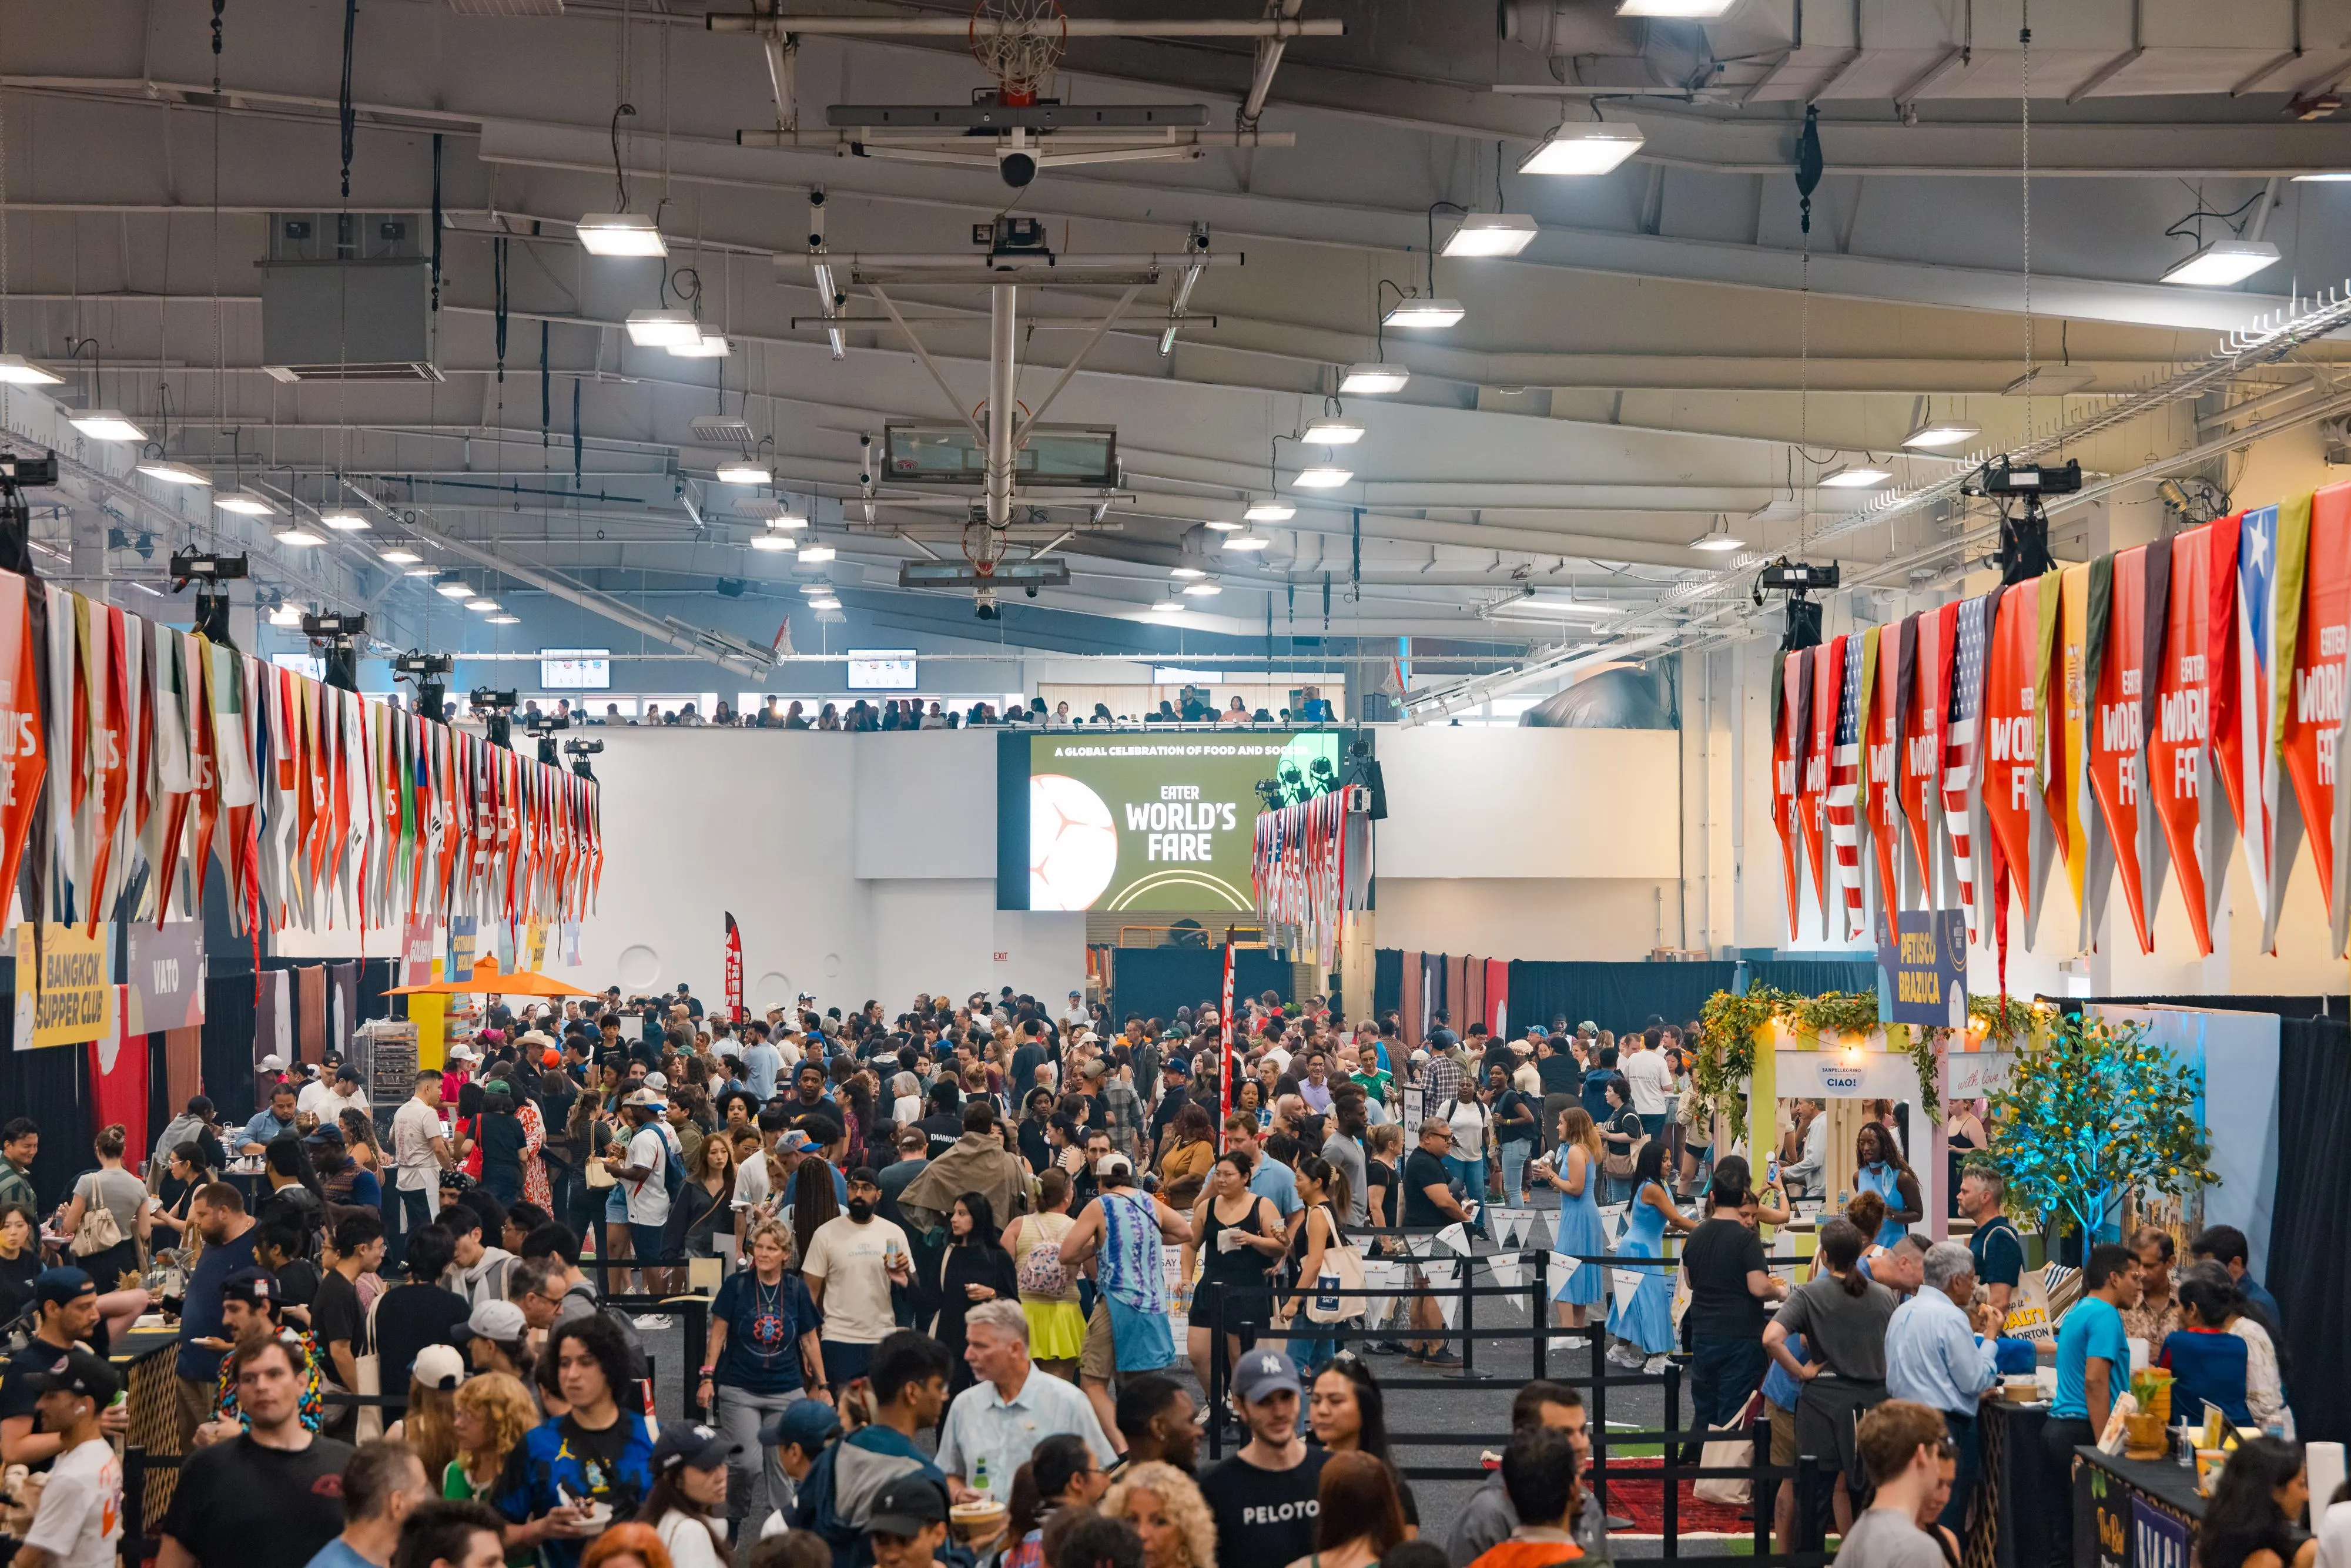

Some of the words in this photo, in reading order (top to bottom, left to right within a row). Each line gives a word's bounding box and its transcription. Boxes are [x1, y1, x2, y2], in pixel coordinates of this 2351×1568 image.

[2296, 662, 2343, 723] WORL
[2161, 686, 2209, 743] WORL
[1054, 747, 1063, 756] A
[1064, 746, 1107, 756] GLOBAL
[1108, 746, 1184, 756] CELEBRATION
[1186, 746, 1202, 756] OF
[1204, 746, 1235, 756] FOOD
[1237, 746, 1263, 755] AND
[1991, 716, 2035, 761] WORL
[2175, 747, 2201, 799] FA
[1161, 785, 1200, 800] EATER
[1125, 802, 1236, 830] WORLD'S
[1148, 833, 1212, 861] FARE
[1900, 932, 1937, 965] PETISCO
[46, 952, 101, 989] BANGKOK
[153, 957, 179, 995] VATO
[731, 951, 741, 1007] FREE
[1898, 970, 1941, 1004] BRAZUCA
[36, 991, 79, 1030] SUPPER
[81, 990, 103, 1025] CLUB
[1827, 1078, 1857, 1087] CIAO!
[1957, 1070, 1978, 1090] with
[1982, 1068, 1999, 1085] love
[1243, 1499, 1321, 1525] PELOTO
